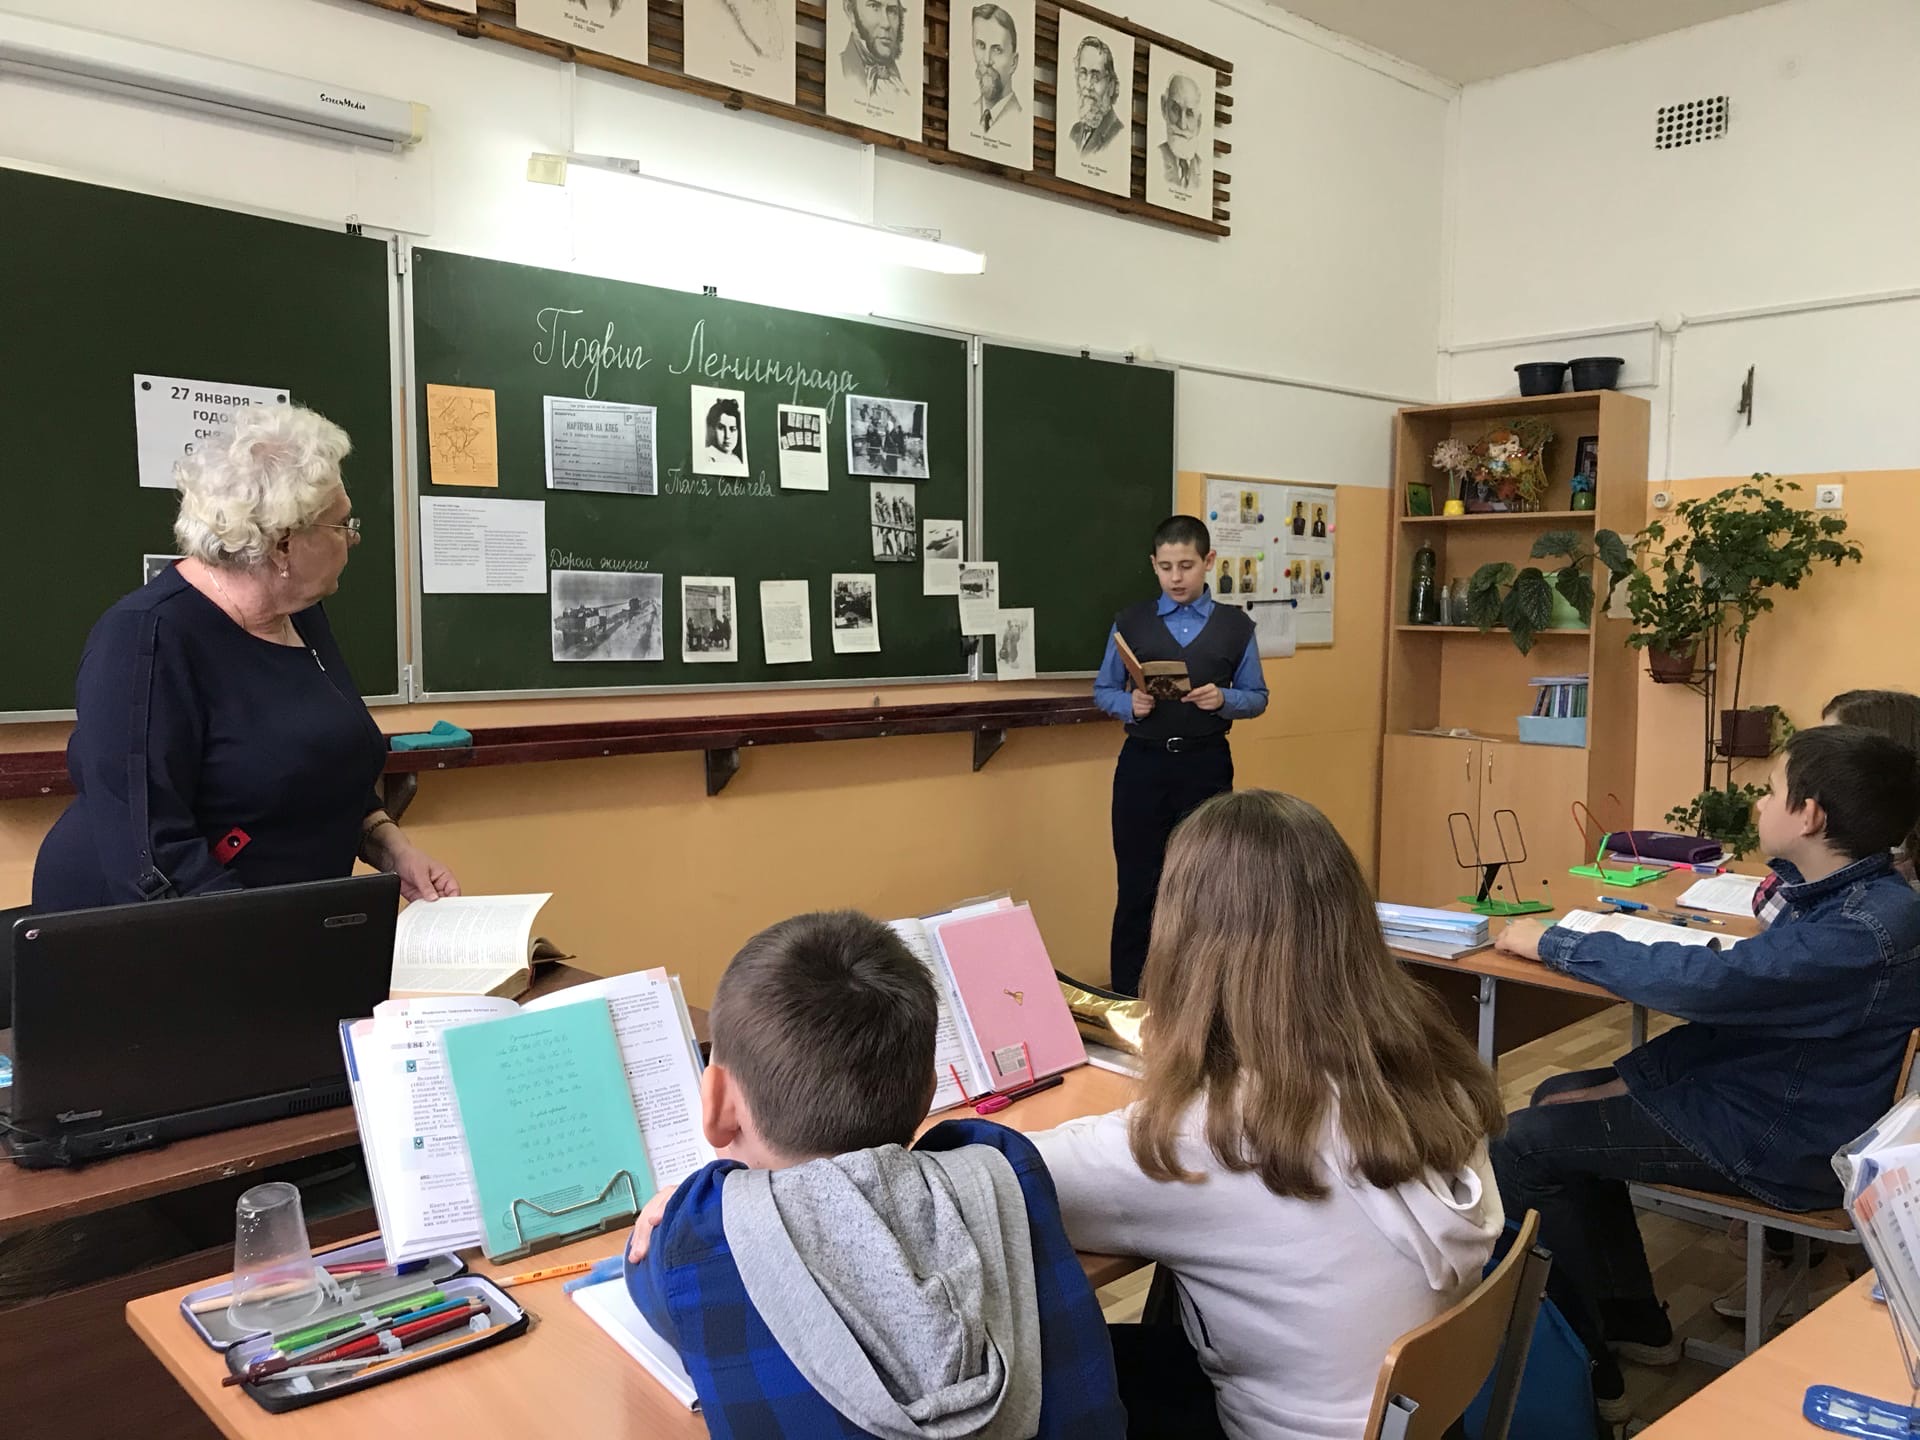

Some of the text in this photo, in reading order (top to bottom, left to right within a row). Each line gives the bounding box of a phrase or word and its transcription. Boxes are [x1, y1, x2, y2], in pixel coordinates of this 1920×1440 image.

[320, 93, 366, 110] ScreenMedia
[533, 307, 860, 424] Подвиг Ленинграда
[170, 386, 190, 400] 27
[194, 391, 250, 408] января
[604, 423, 619, 433] ХЛЕБ
[664, 468, 713, 497] Таня
